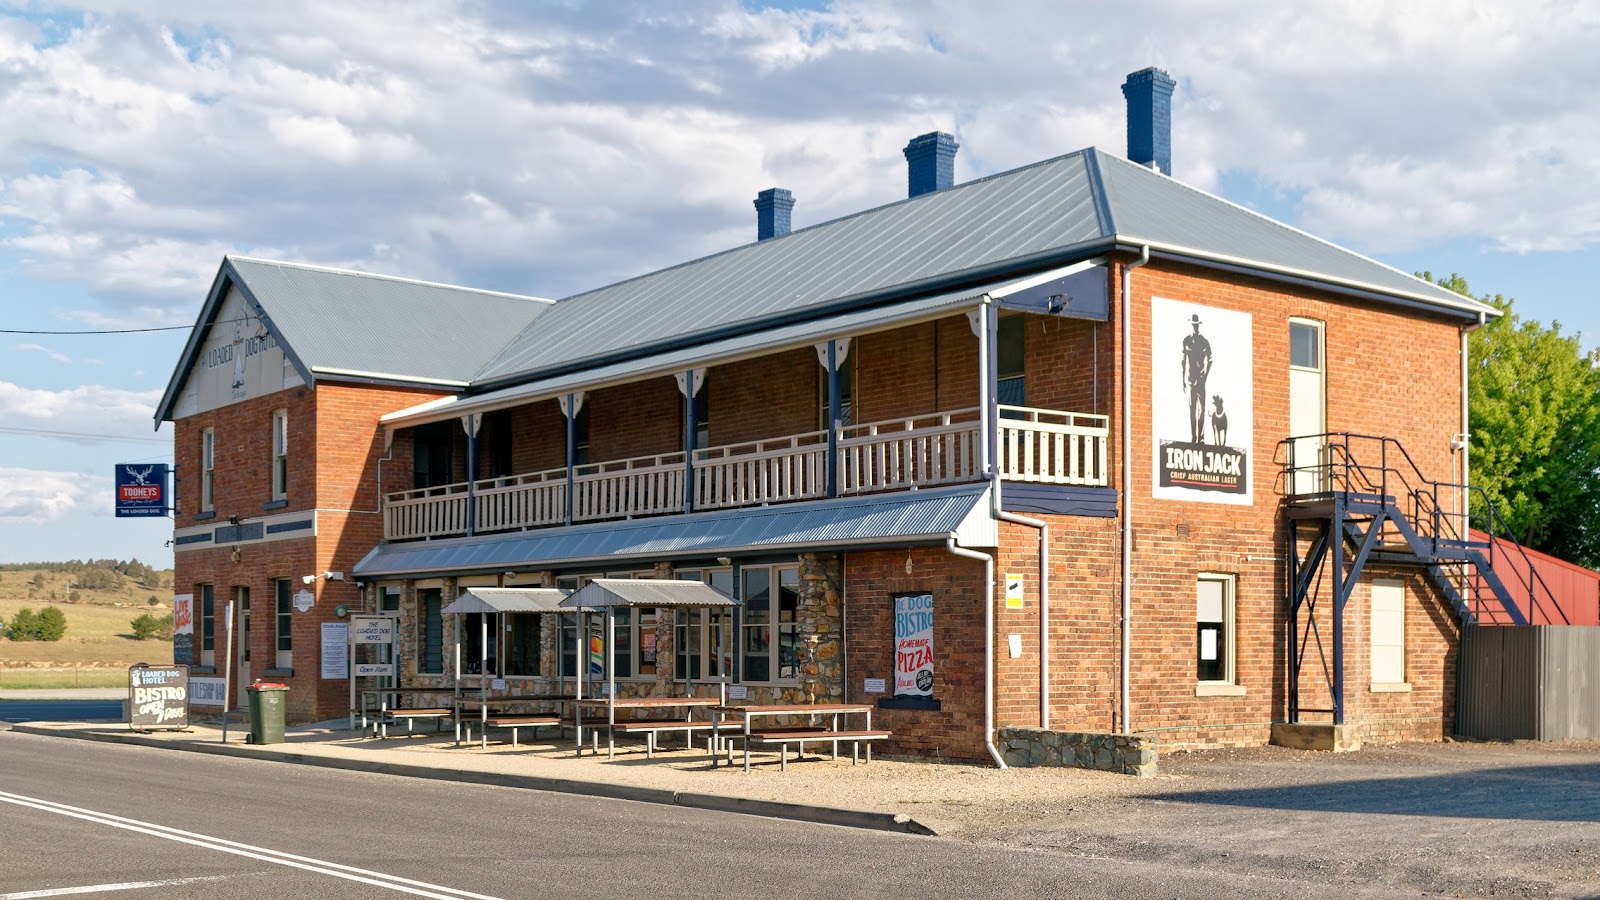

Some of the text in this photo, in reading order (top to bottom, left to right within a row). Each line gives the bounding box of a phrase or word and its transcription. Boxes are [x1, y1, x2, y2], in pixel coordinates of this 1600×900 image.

[208, 344, 233, 368] LOADED
[245, 337, 258, 357] DOG
[1166, 447, 1242, 476] IRON JACK
[1170, 471, 1237, 484] CRISP AUSTRALIAN LAGER
[123, 487, 157, 497] TOOHEYS
[175, 599, 189, 615] LIVE
[896, 596, 932, 612] THE DOG
[896, 612, 934, 638] BISTRO
[898, 638, 930, 650] HOMEMADE
[897, 646, 934, 673] PIZZA
[359, 666, 374, 674] Open
[134, 686, 186, 704] BISTRO
[139, 699, 165, 715] OPEN
[156, 709, 165, 724] 7
